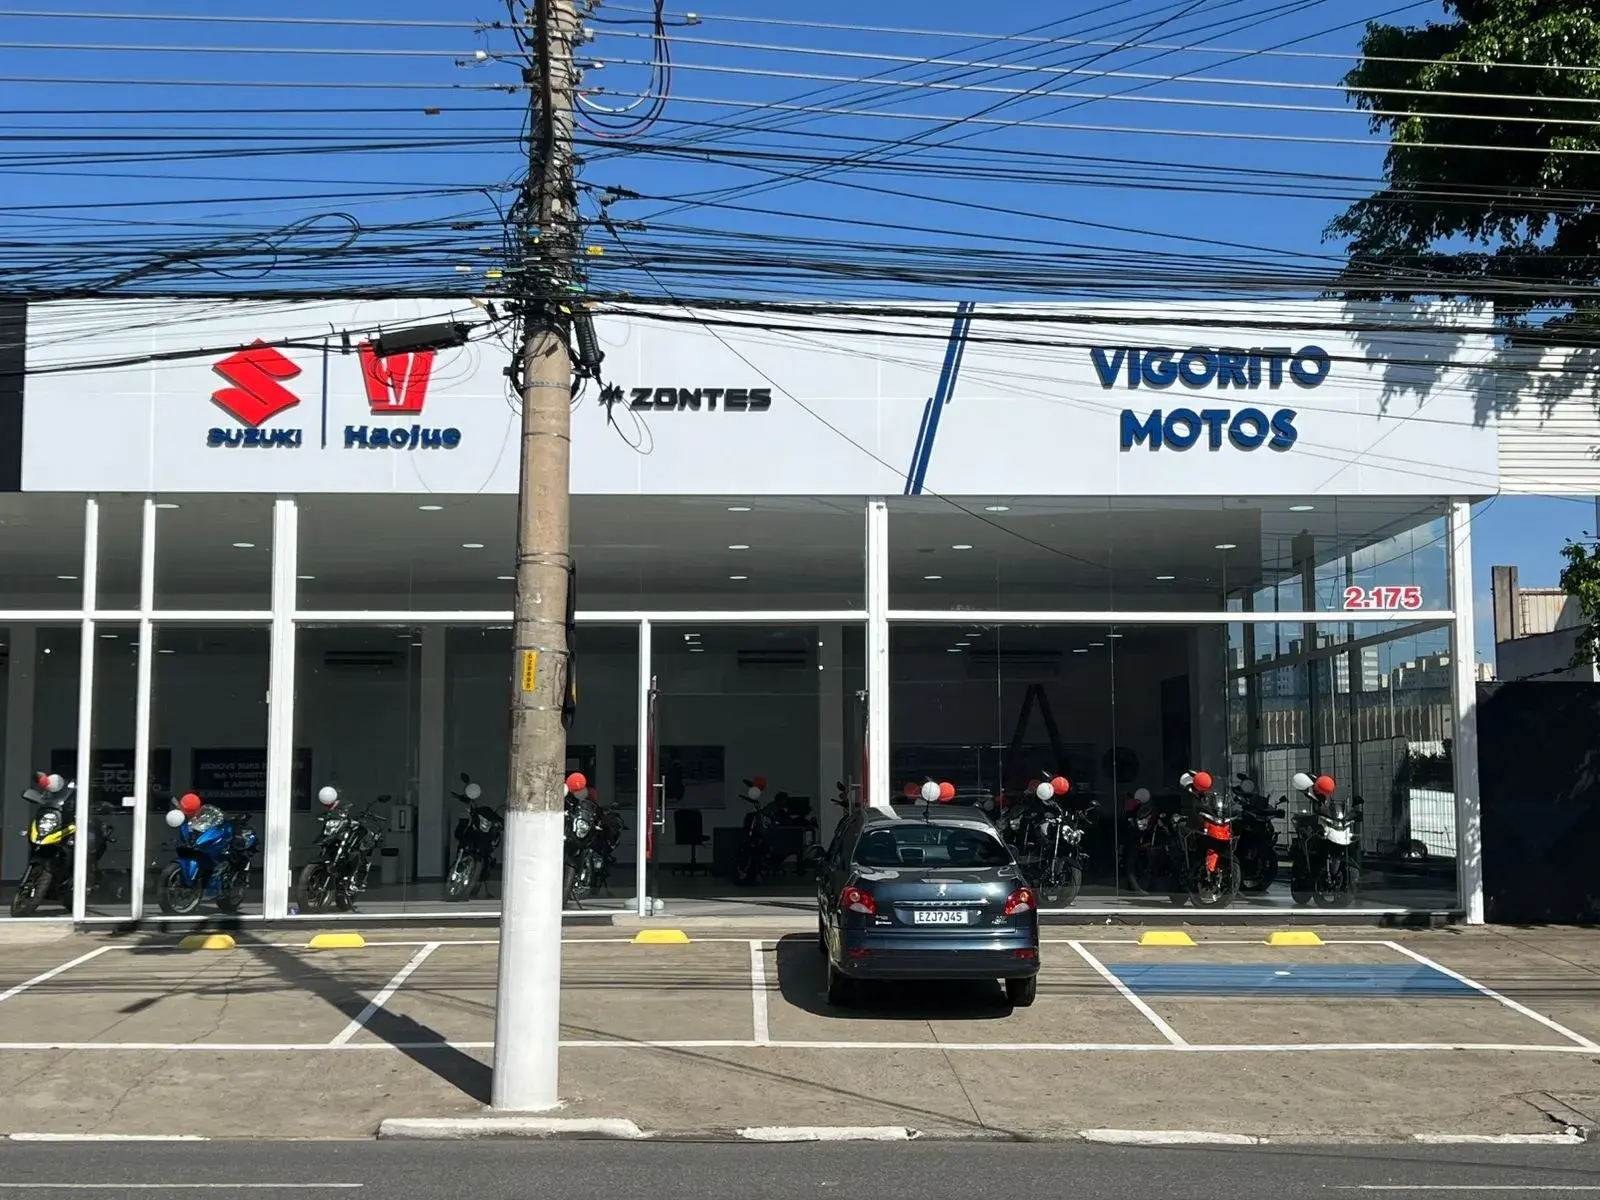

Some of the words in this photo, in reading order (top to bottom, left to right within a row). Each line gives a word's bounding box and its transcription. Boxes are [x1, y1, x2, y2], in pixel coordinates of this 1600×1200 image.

[1090, 345, 1331, 390] VIGORITO
[630, 388, 772, 412] ZONTES
[206, 427, 303, 449] SUZUKI
[344, 424, 462, 450] Haojue
[1120, 408, 1298, 452] MOTOS
[1344, 586, 1422, 609] 2.175
[918, 911, 962, 922] EZJ7J45
